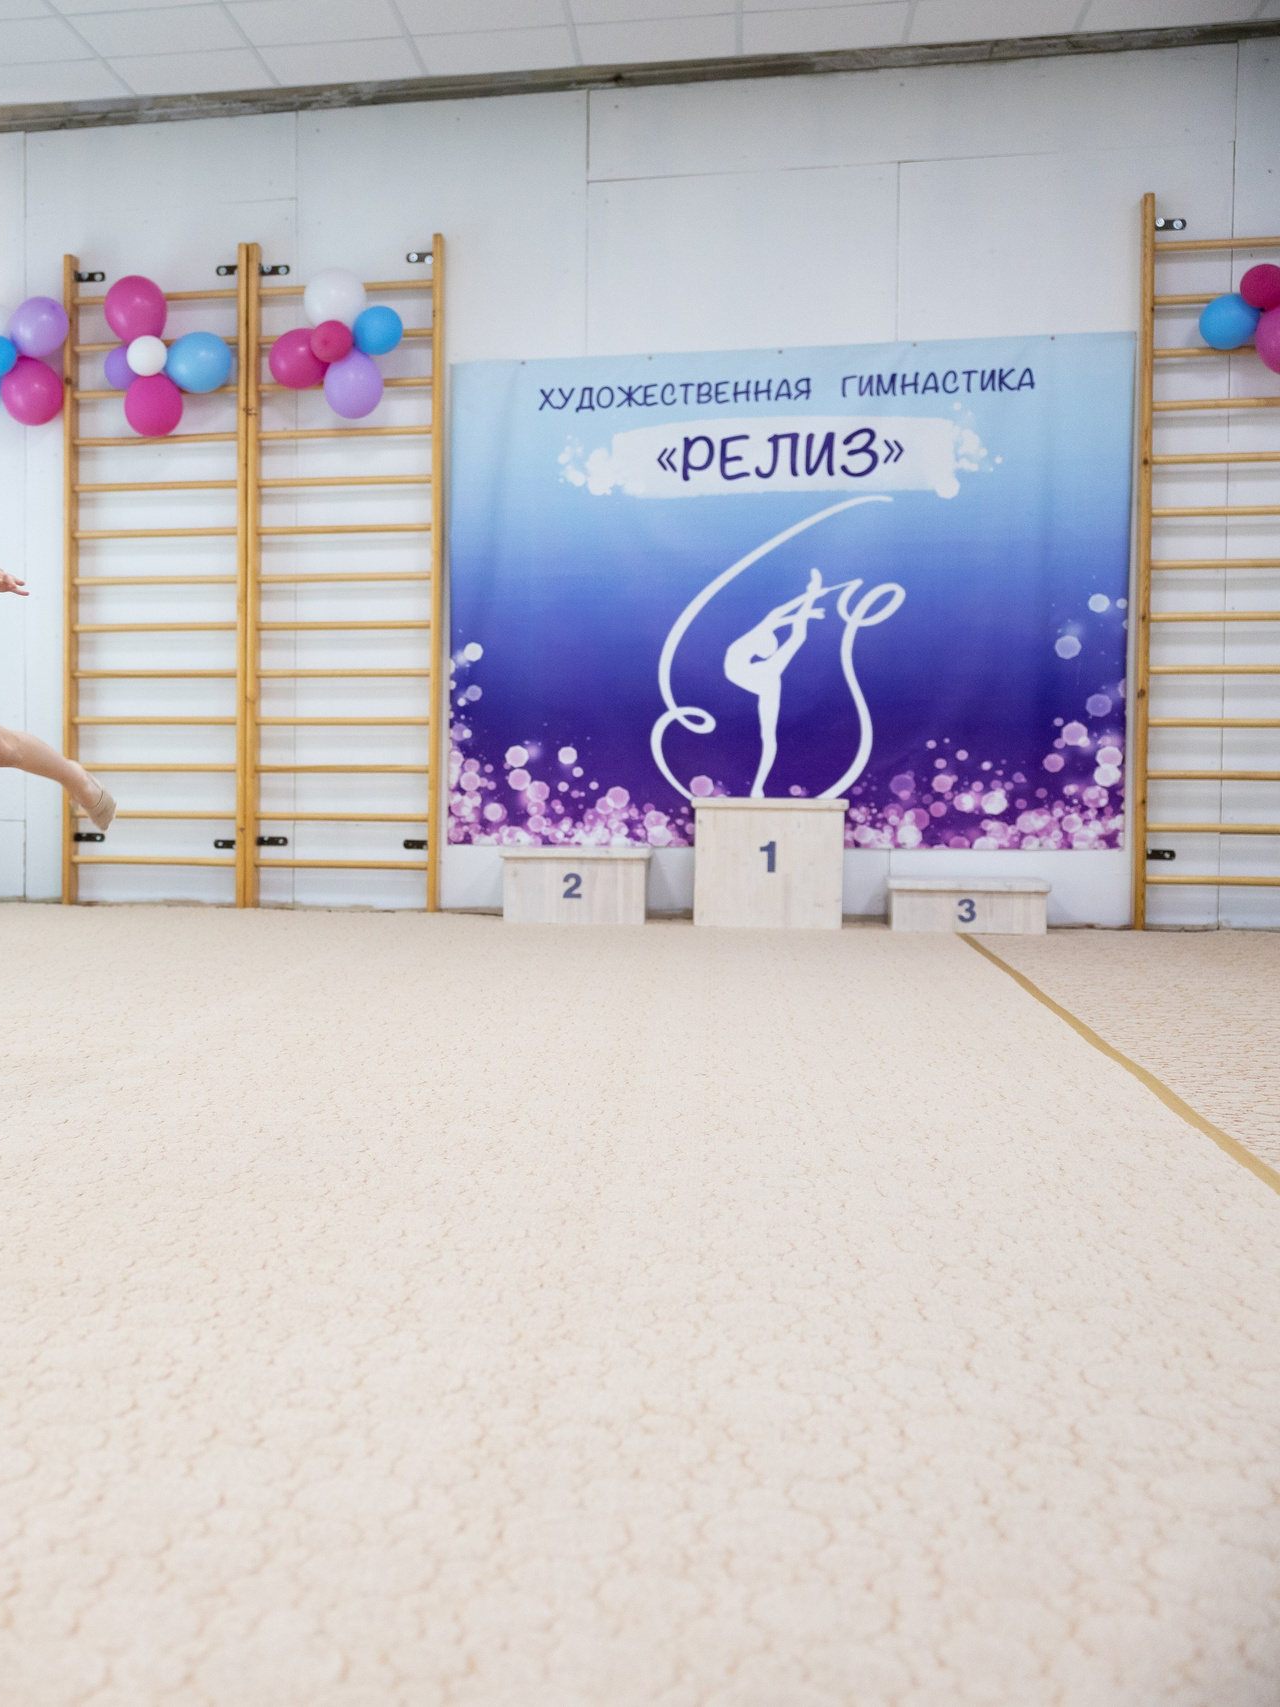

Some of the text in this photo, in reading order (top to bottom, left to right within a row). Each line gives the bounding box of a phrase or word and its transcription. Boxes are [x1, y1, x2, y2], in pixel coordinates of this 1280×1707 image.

[538, 367, 1036, 414] ХУДОЖЕСТВЕННАЯ ГИМНАСТИКА
[656, 427, 905, 483] «РЕЛИЗ»
[759, 840, 777, 874] 1
[562, 872, 583, 900] 2
[956, 898, 977, 924] 3
